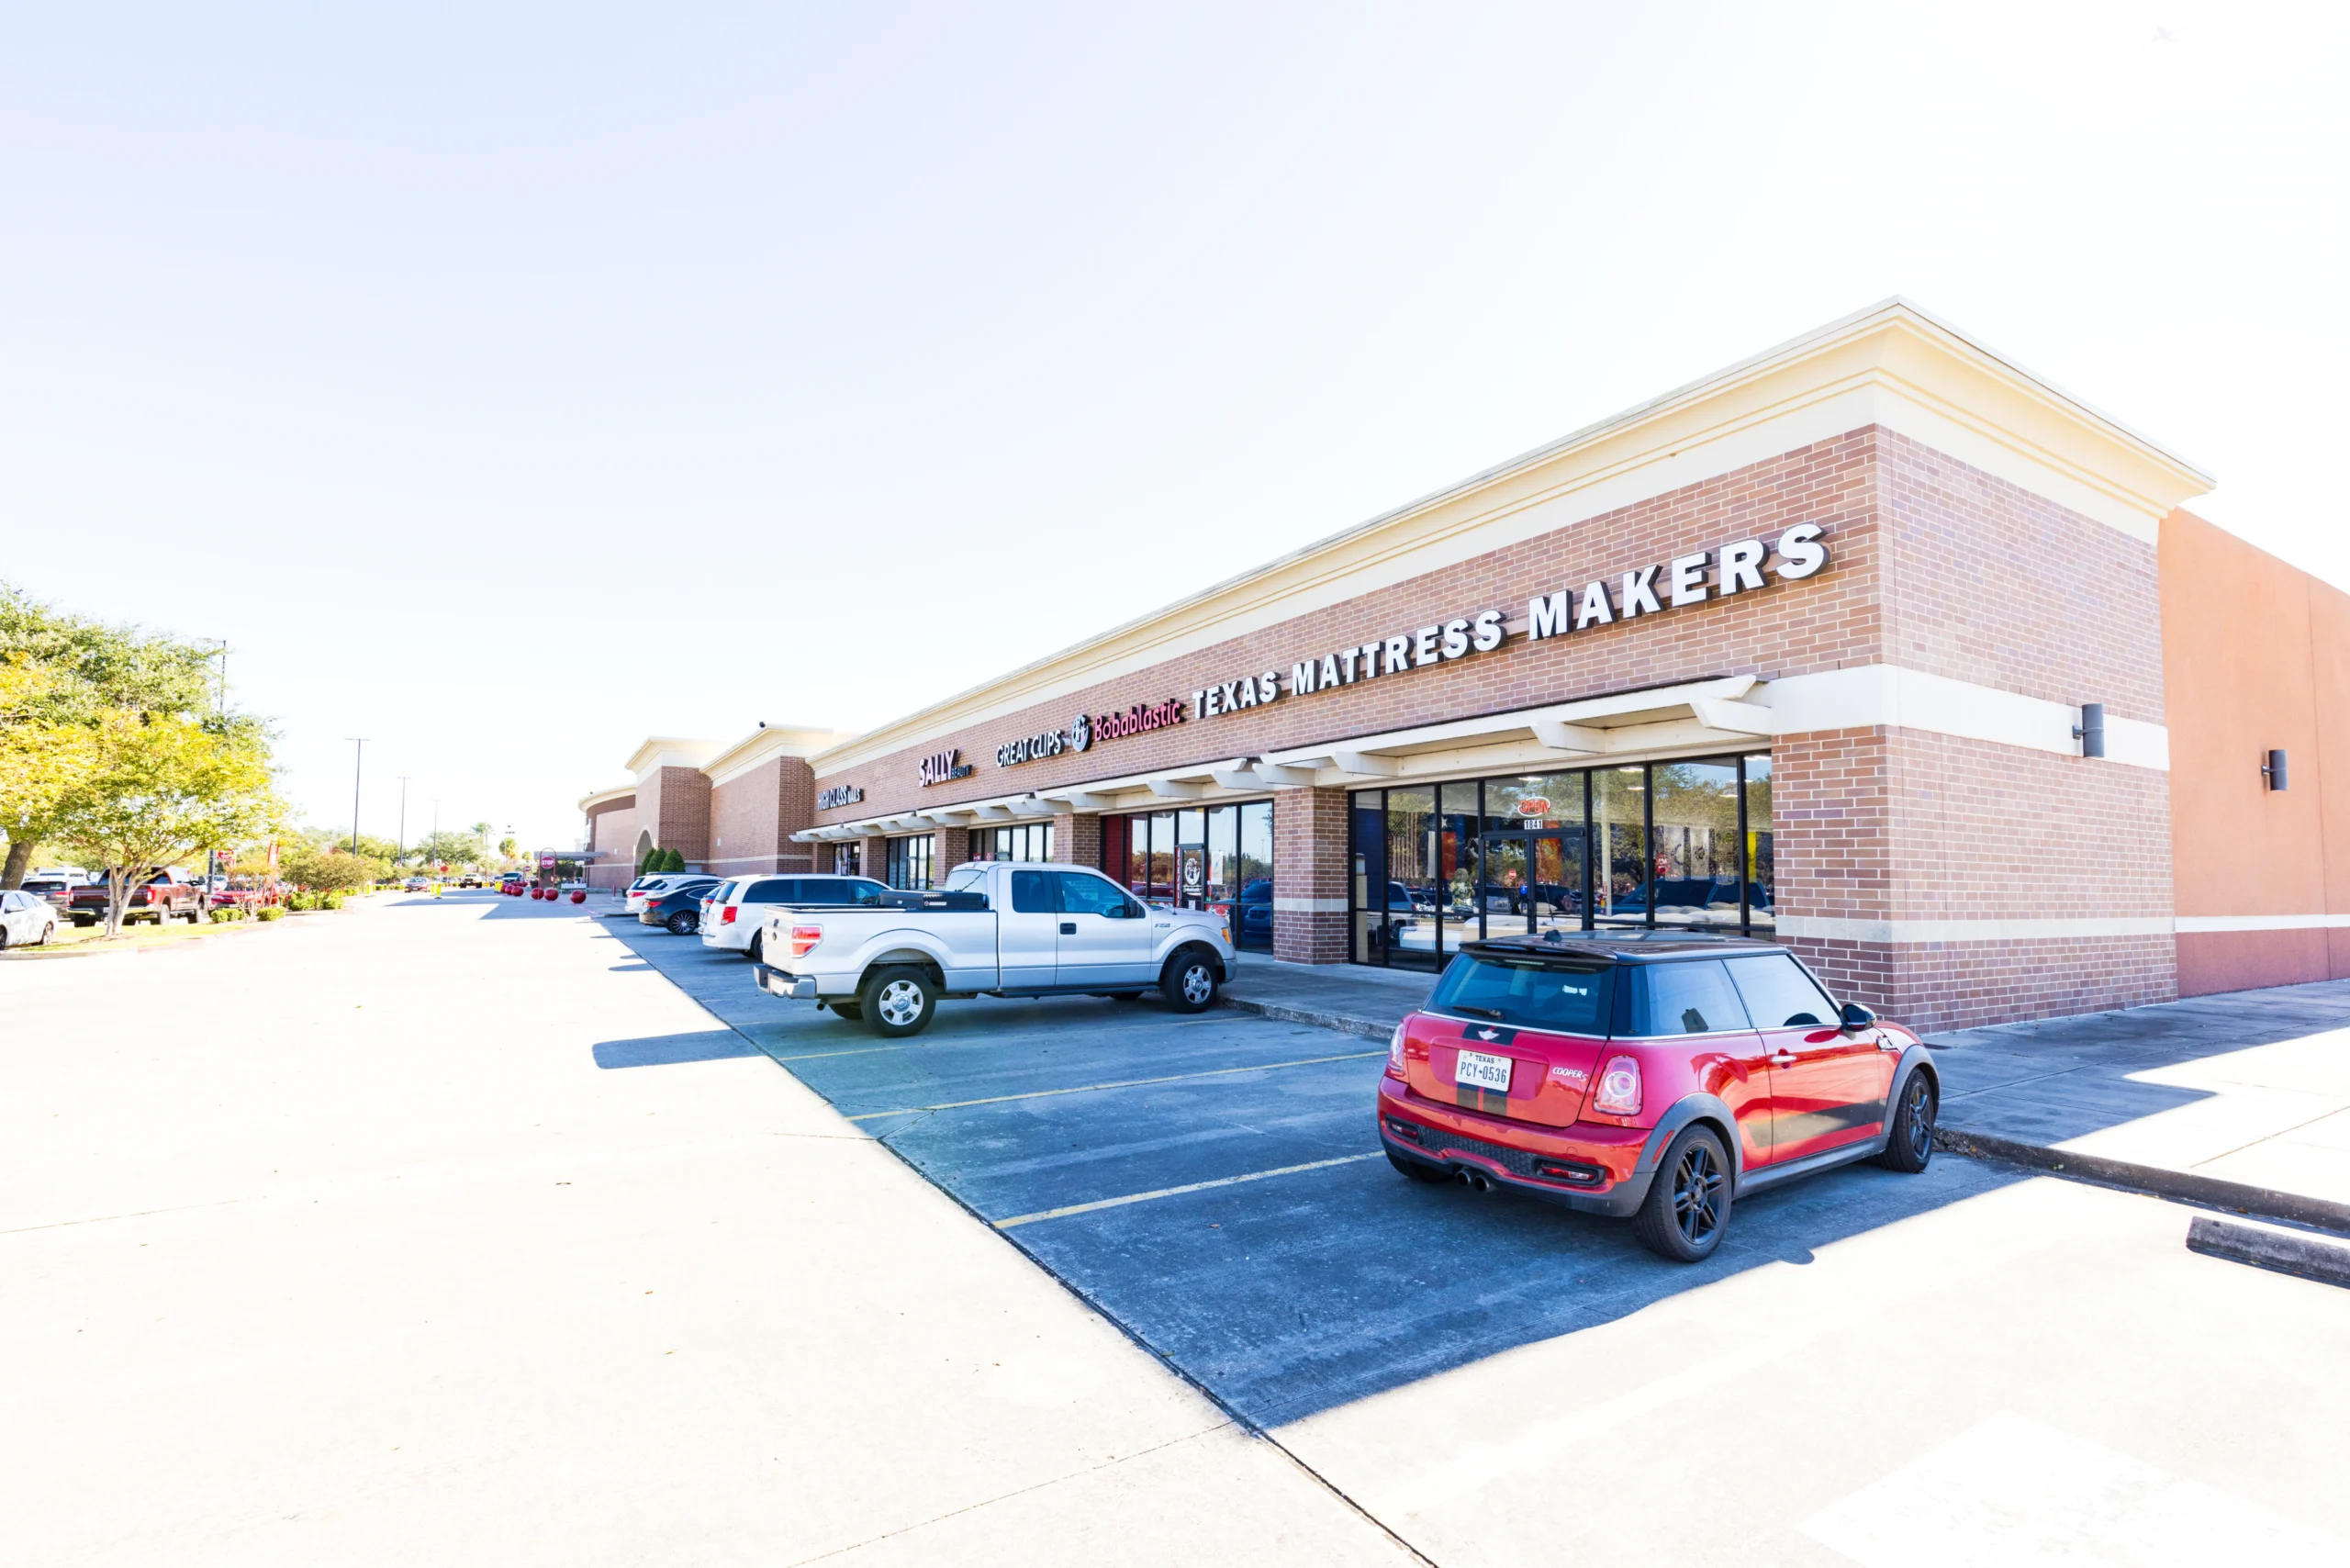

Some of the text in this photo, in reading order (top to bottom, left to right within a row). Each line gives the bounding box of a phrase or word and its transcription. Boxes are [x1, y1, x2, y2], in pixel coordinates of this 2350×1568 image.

[1192, 523, 1831, 719] TEXAS MATTRESS MAKERS
[1094, 698, 1181, 742] Bobablastic
[996, 729, 1062, 767] GREAT CLIPS
[919, 749, 956, 787] SALLY
[951, 765, 970, 779] BEAUTY
[830, 785, 848, 808] CLASS
[1519, 800, 1550, 813] OPEN
[1525, 820, 1542, 829] 1841
[1475, 1055, 1495, 1064] TEXAS
[1552, 1067, 1583, 1079] COOPER
